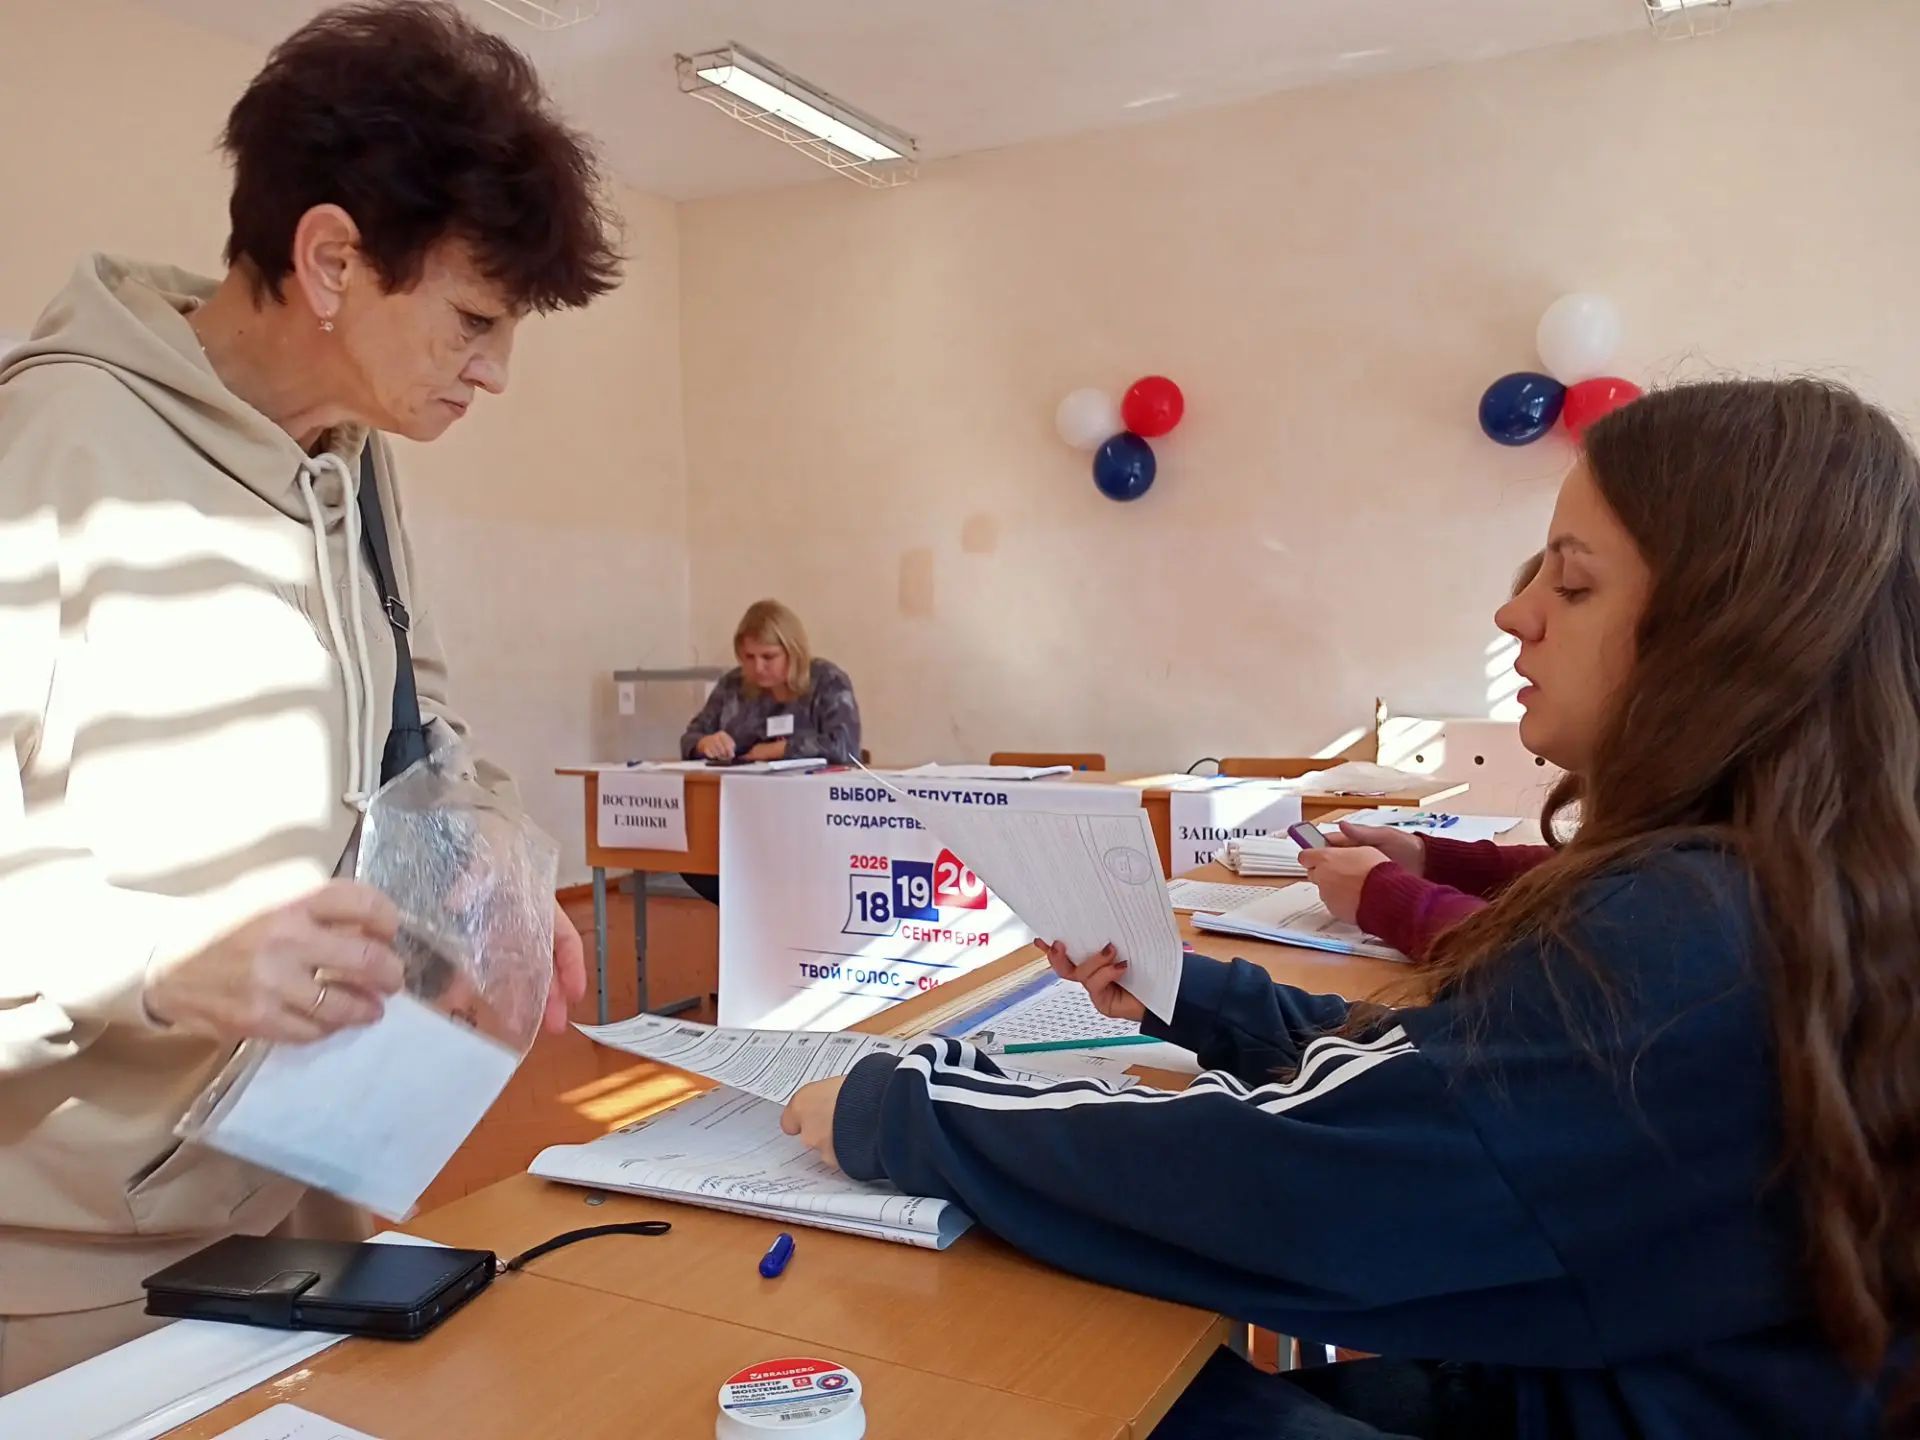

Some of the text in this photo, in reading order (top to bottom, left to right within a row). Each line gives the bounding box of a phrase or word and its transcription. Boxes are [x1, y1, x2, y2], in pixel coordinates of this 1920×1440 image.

[602, 794, 679, 809] ВОСТОЧНАЯ
[614, 814, 667, 828] ГЛИНКИ
[826, 814, 926, 830] ГОСУДАРСТВЕ
[850, 855, 888, 870] 2026
[856, 862, 984, 923] 18 19 20
[902, 925, 989, 947] СЕНТЯБРЯ
[799, 962, 841, 980] ТВОЙ
[847, 968, 900, 987] ГОЛОС
[762, 1366, 815, 1378] BRAUBERG
[730, 1380, 782, 1390] FINGERTIP
[731, 1385, 790, 1395] MOISTENER
